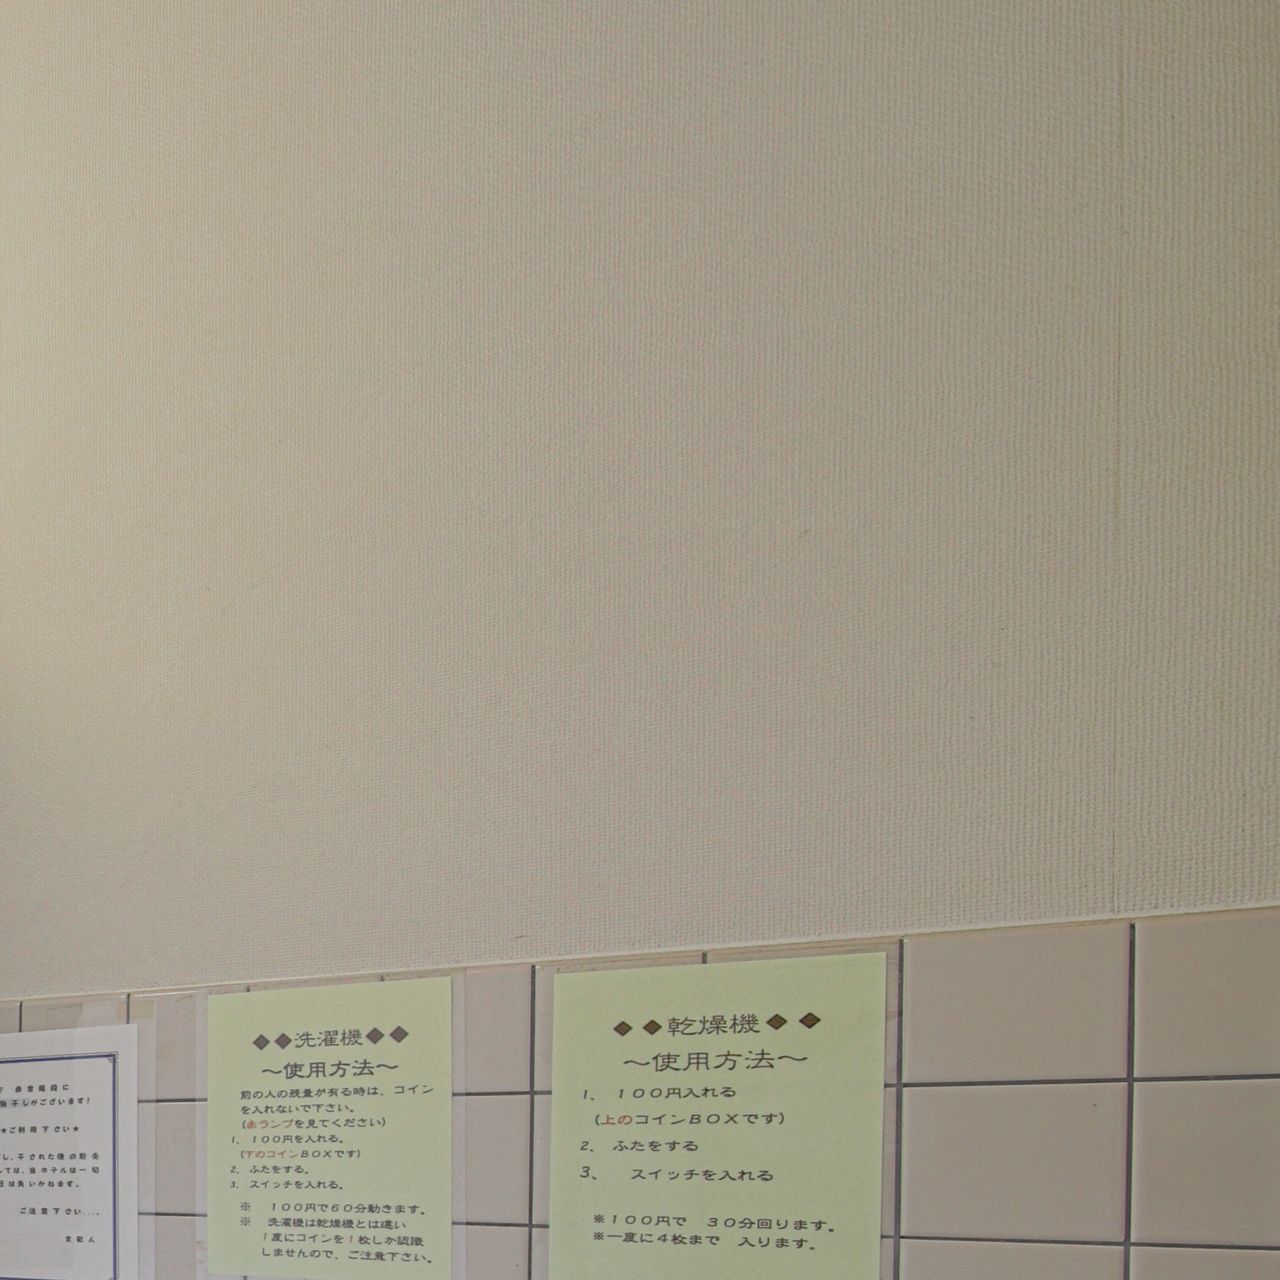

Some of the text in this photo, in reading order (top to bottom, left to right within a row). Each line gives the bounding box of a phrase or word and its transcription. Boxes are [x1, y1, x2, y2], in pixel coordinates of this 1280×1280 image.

[666, 1013, 761, 1036] 乾燥機
[294, 1029, 364, 1049] 洗濯機
[617, 1086, 737, 1100] 100円入れる
[240, 1103, 355, 1115] を入れないで下さい。
[594, 1112, 785, 1126] (上のコインBOXです)
[612, 1139, 699, 1152] ふたをする
[630, 1168, 774, 1182] スイッチを入れる
